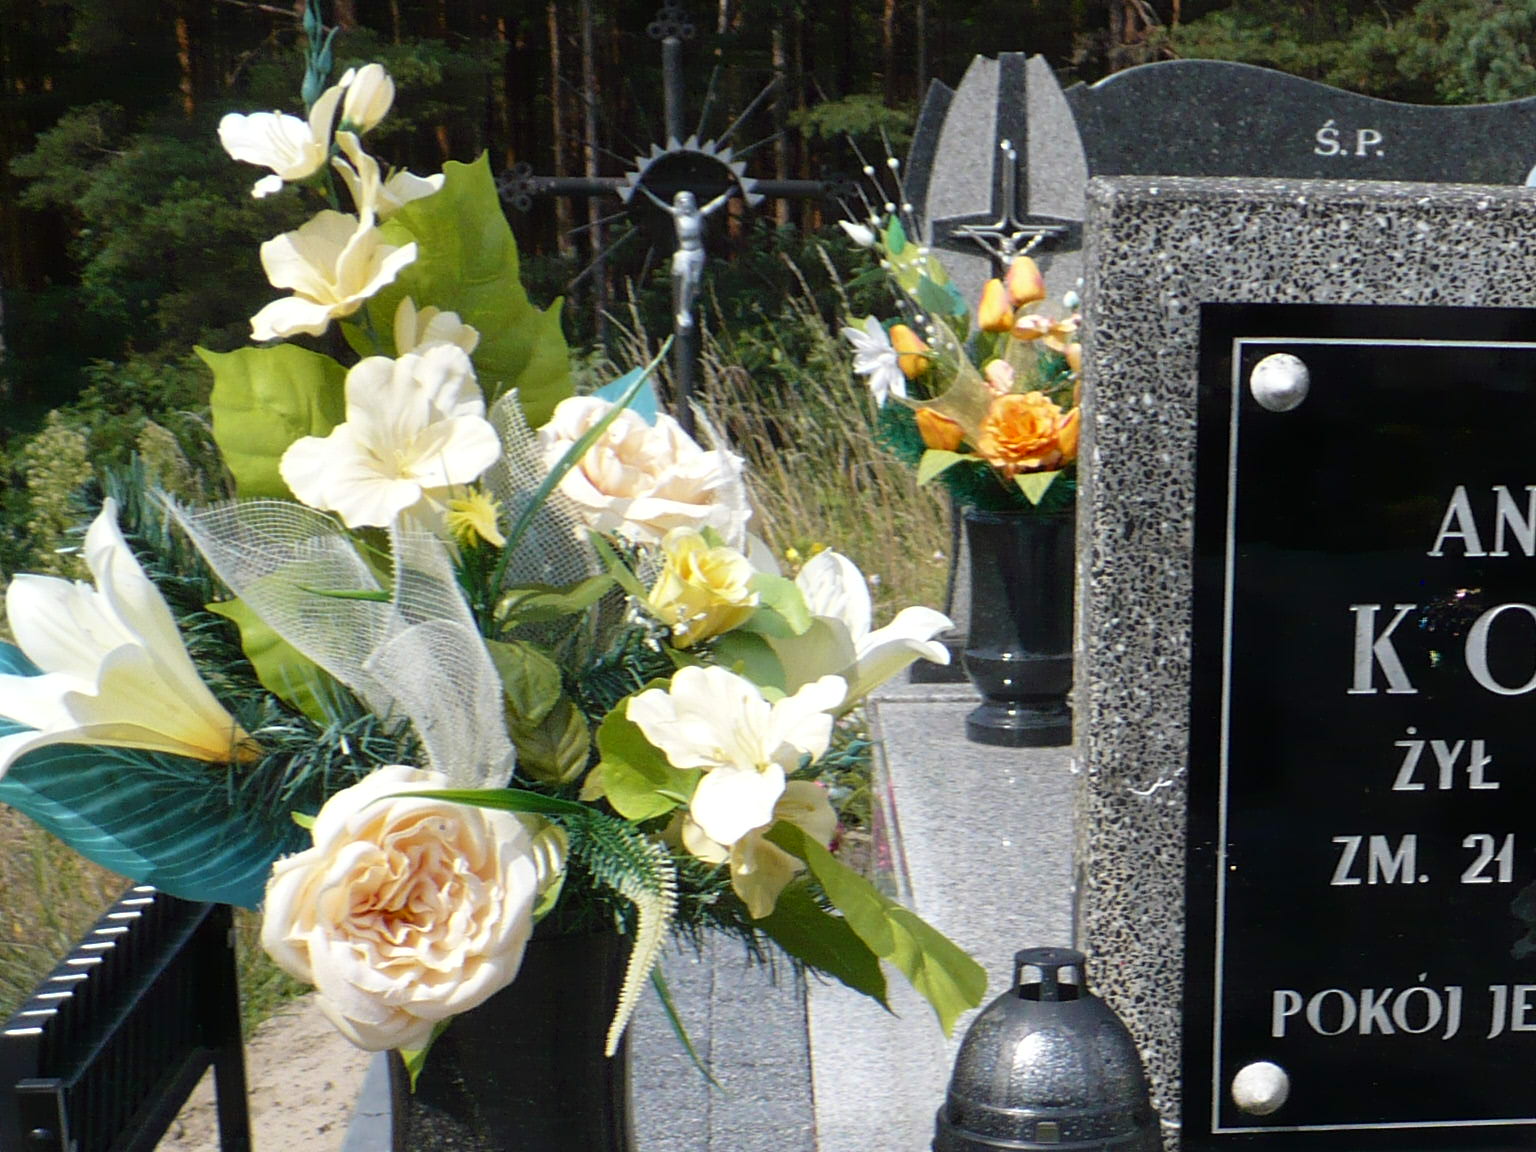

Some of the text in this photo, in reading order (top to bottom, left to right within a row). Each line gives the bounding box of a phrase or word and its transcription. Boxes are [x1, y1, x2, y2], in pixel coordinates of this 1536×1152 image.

[1391, 727, 1500, 791] ŻYŁ
[1330, 834, 1429, 886] ZM.
[1460, 833, 1515, 885] 21
[1272, 972, 1462, 1041] POKÓJ
